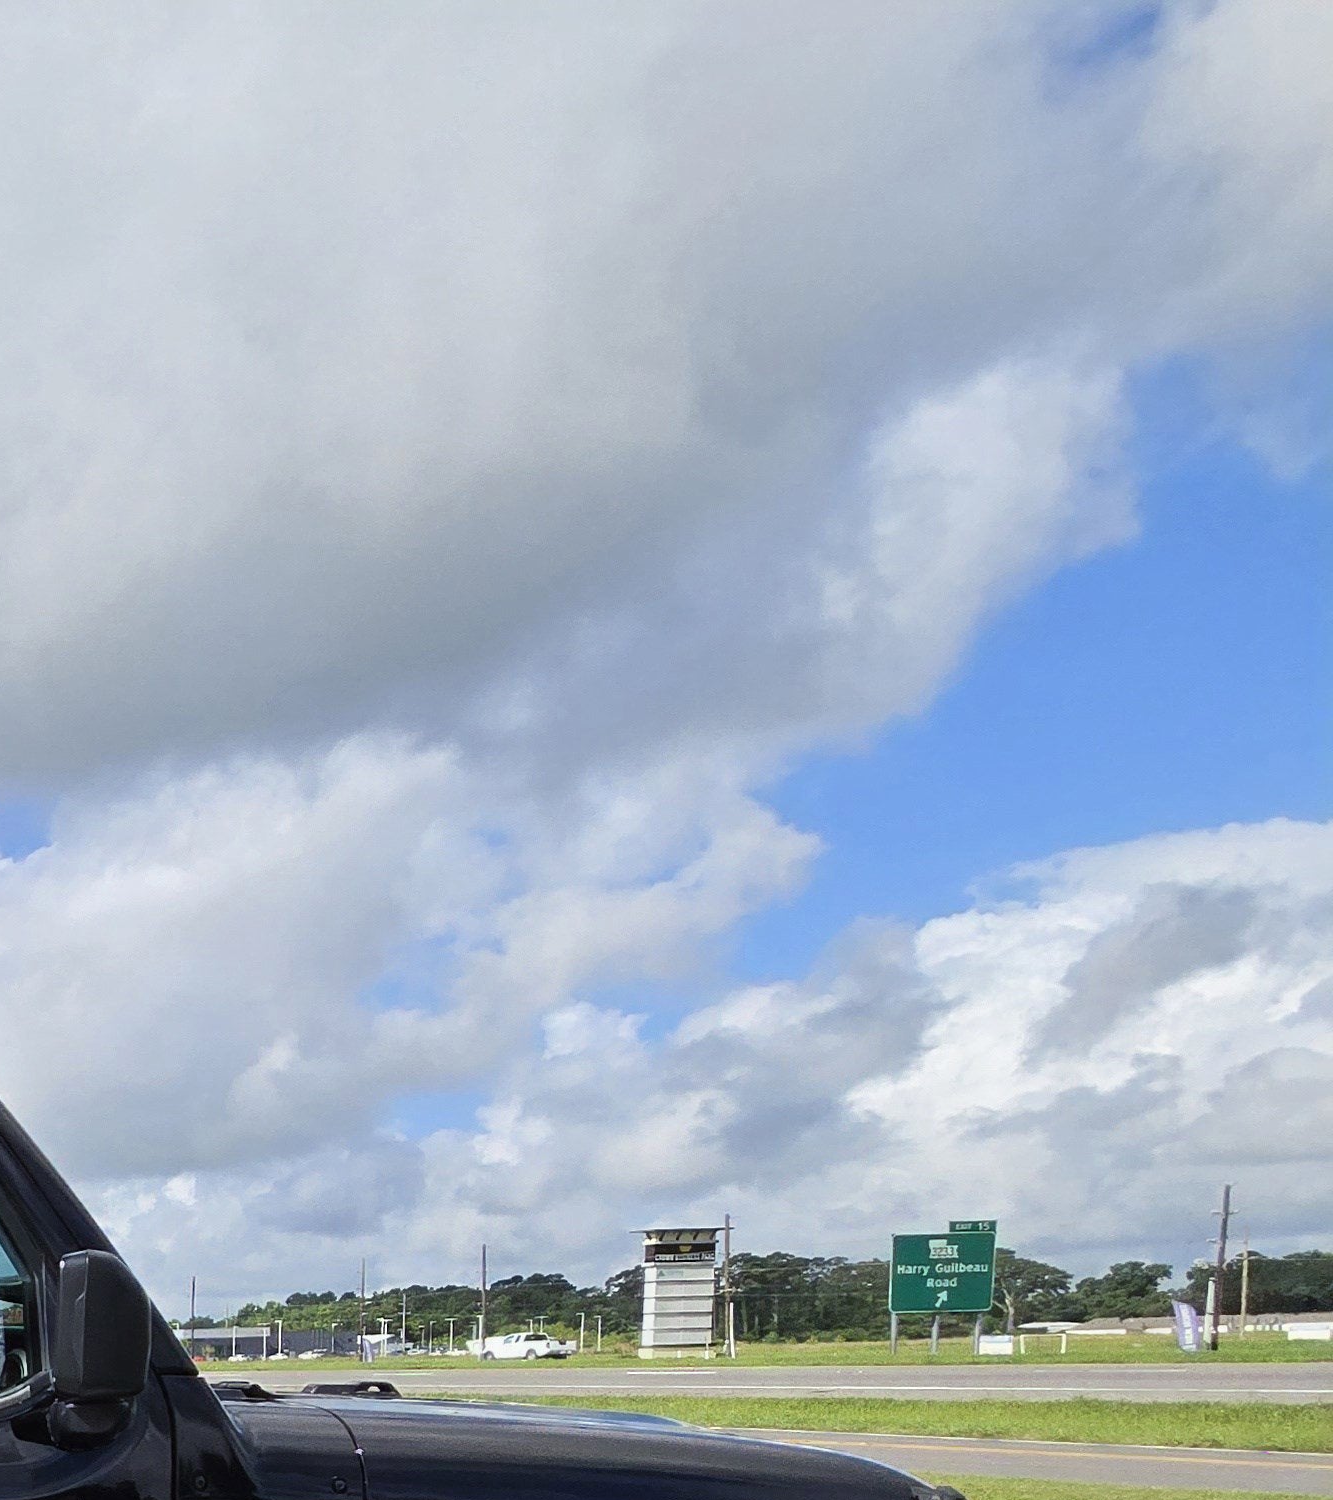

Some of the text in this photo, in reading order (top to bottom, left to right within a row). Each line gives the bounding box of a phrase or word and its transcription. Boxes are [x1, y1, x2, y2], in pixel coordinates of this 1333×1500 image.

[955, 1222, 990, 1231] EXIT 15
[897, 1262, 988, 1276] Harry Guilbeau
[926, 1276, 958, 1288] Road
